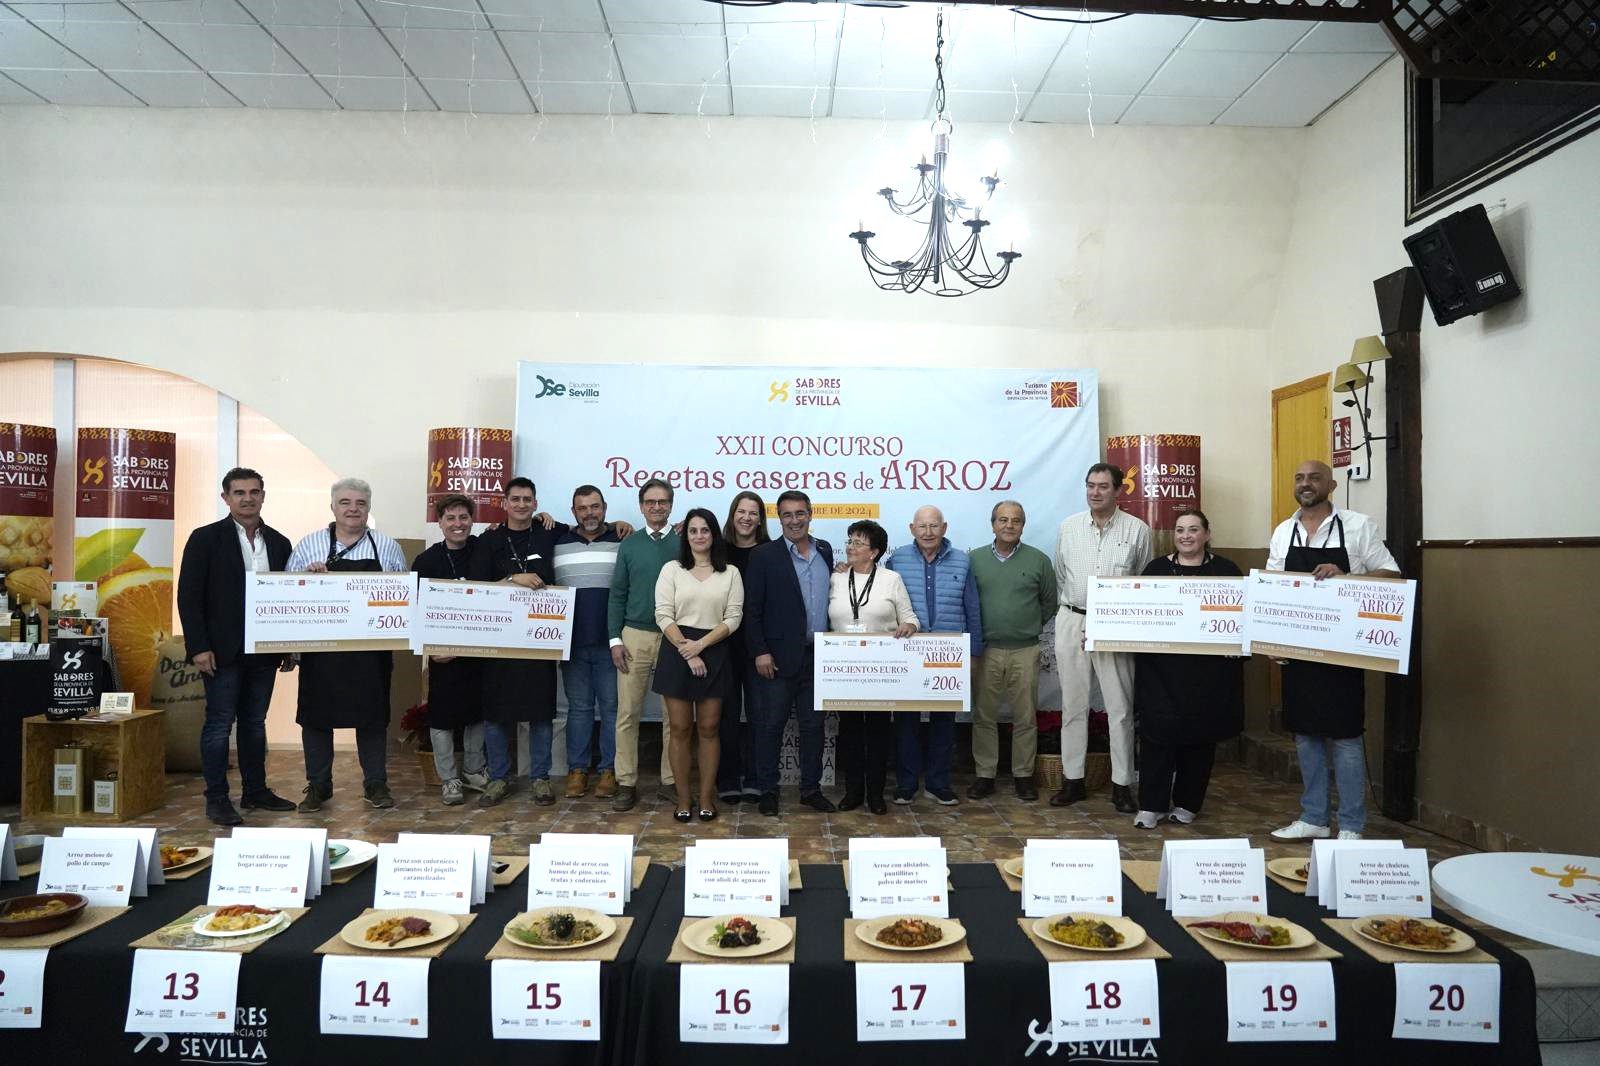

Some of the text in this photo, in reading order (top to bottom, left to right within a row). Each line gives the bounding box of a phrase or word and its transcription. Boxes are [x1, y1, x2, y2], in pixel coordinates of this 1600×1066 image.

[796, 378, 840, 388] SABORES
[568, 388, 600, 397] Sevilla
[796, 395, 840, 406] SEVILLA
[715, 436, 903, 457] XXII CONCURSO
[0, 451, 48, 465] ABORES
[113, 456, 168, 469] SABORES
[448, 457, 503, 469] SABORES
[8, 465, 41, 473] PROVINCIA
[606, 457, 1012, 492] Recetas caseras de ARROZ
[1144, 464, 1195, 476] SABORES
[0, 472, 47, 487] EVILLA
[113, 476, 168, 490] SEVILLA
[447, 478, 503, 491] SEVILLA
[1144, 485, 1196, 498] SEVILLA
[369, 590, 409, 600] ARROZ
[1200, 595, 1243, 605] ARROZ
[256, 605, 350, 616] QUINIENTOS EUROS
[529, 604, 567, 615] ARROZ
[1095, 608, 1184, 617] TRESCIENTOS EUROS
[1359, 599, 1404, 615] ARROZ
[426, 612, 512, 623] SEISCIENTOS EUROS
[1254, 605, 1315, 619] CUATROCIENTOS
[1315, 613, 1341, 623] EUROS
[924, 652, 962, 663] ARROZ
[823, 665, 909, 674] DOSCIENTOS EUROS
[54, 672, 94, 681] SABORES
[53, 687, 94, 697] SEVILLA
[163, 972, 200, 1000] 13
[355, 980, 390, 1007] 14
[526, 983, 562, 1010] 15
[891, 984, 927, 1011] 17
[1085, 981, 1121, 1010] 18
[1262, 984, 1297, 1012] 19
[1428, 984, 1465, 1011] 20
[715, 988, 751, 1014] 16
[257, 1029, 267, 1037] DE
[180, 1038, 267, 1059] SEVILLA
[1068, 1039, 1158, 1057] SEVILLA
